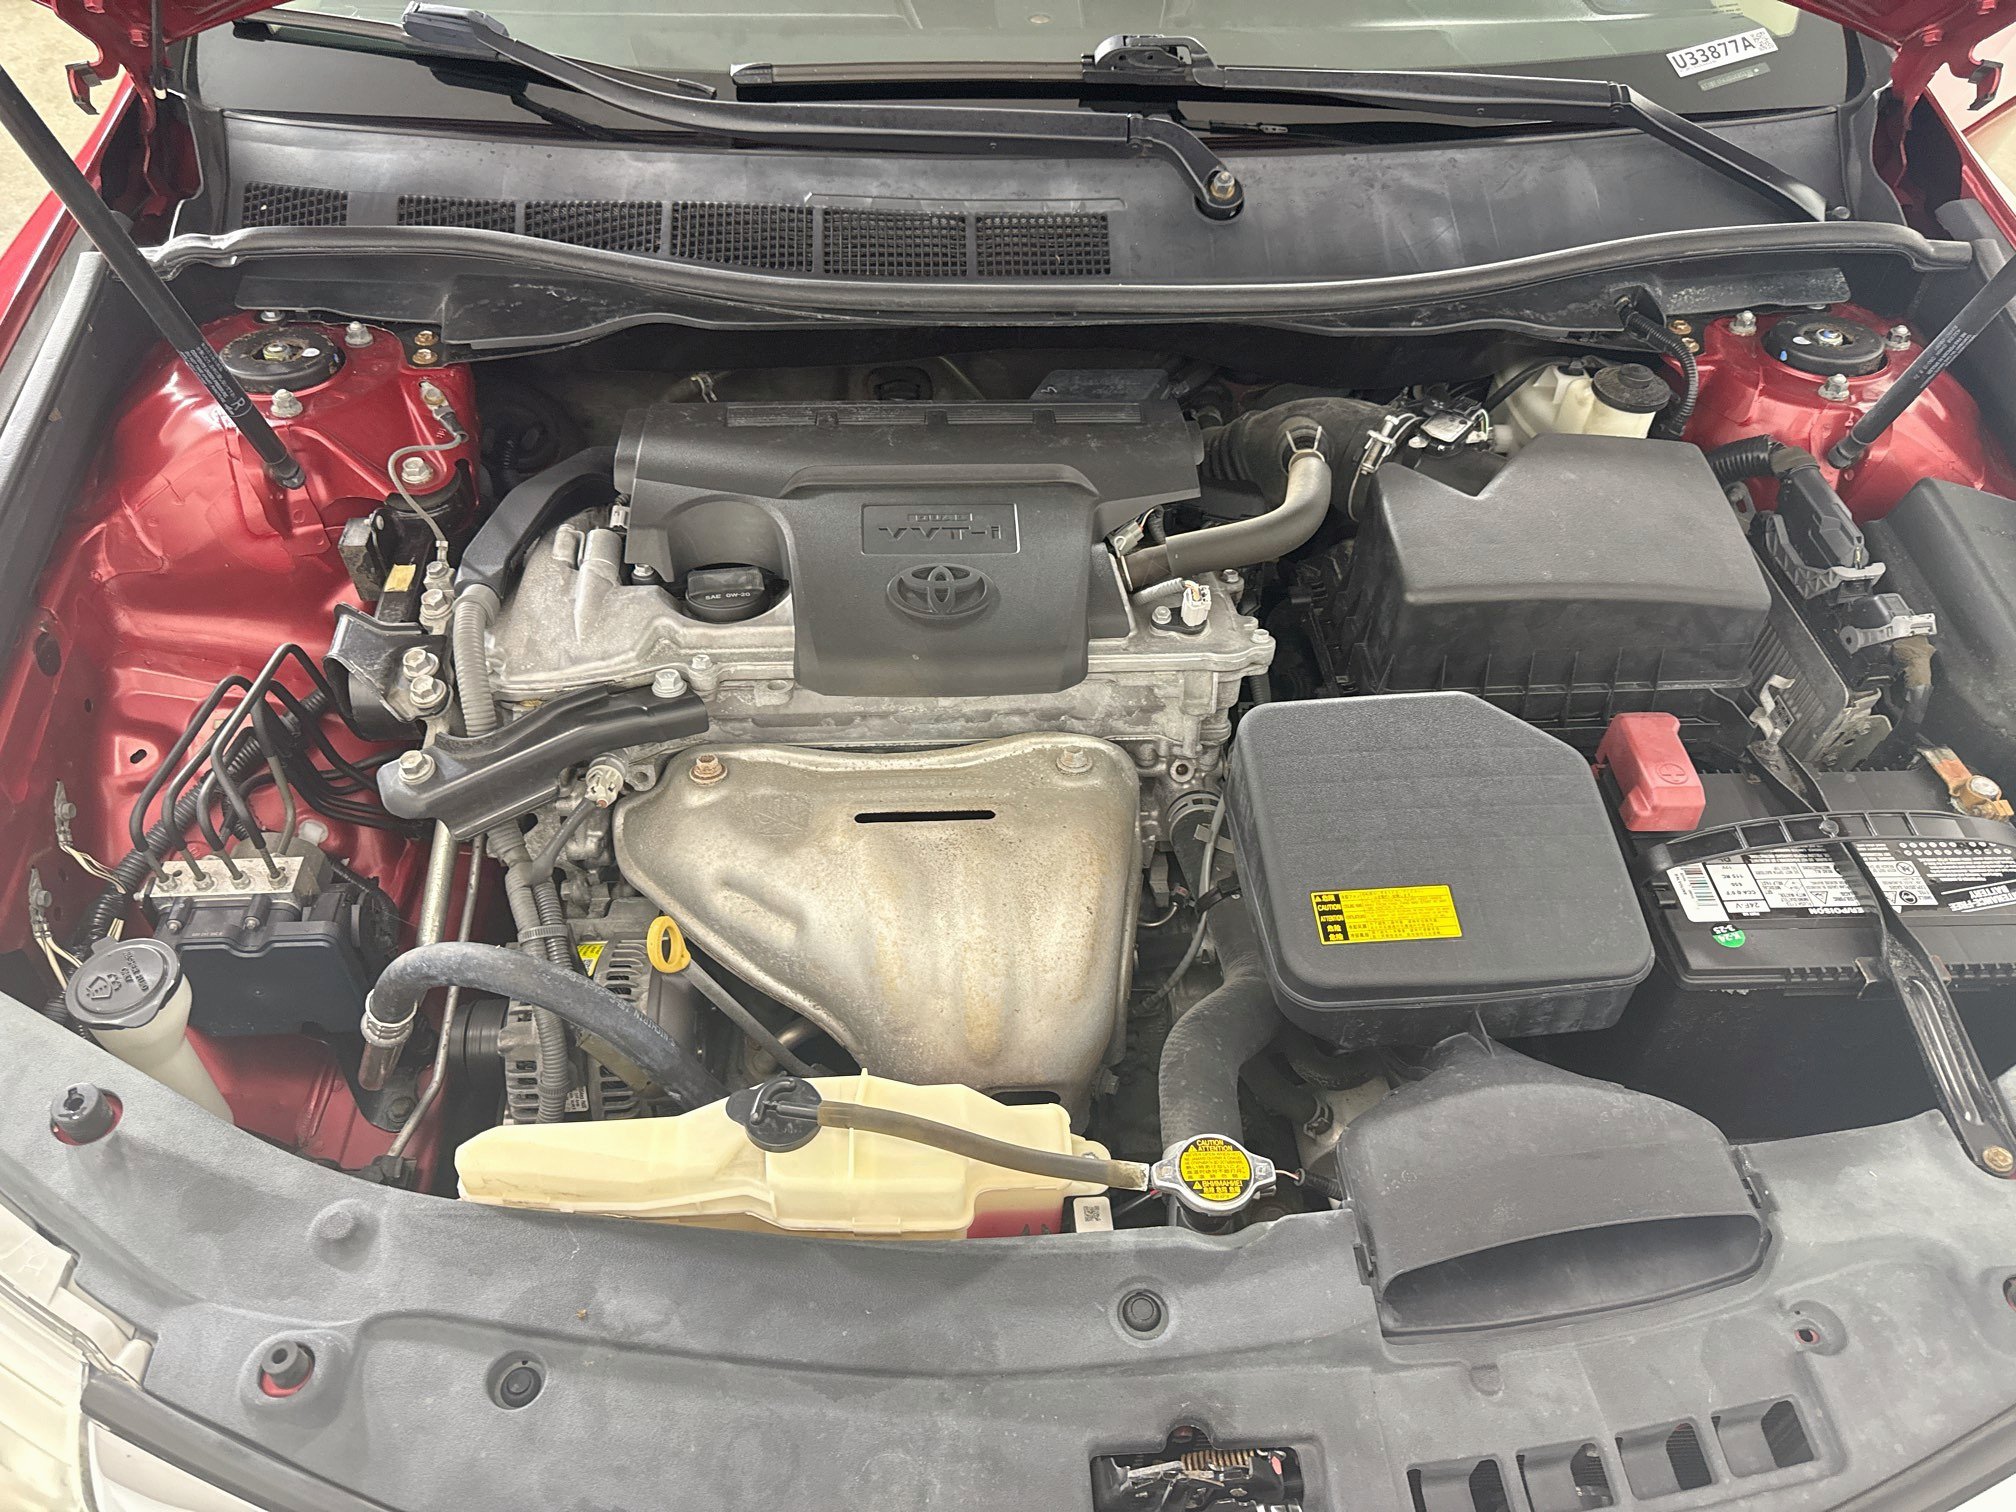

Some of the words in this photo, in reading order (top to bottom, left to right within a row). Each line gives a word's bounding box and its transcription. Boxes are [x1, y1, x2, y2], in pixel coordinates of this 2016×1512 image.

[1672, 36, 1755, 69] U33877A
[231, 397, 246, 411] R
[1968, 885, 2010, 900] BATTERY
